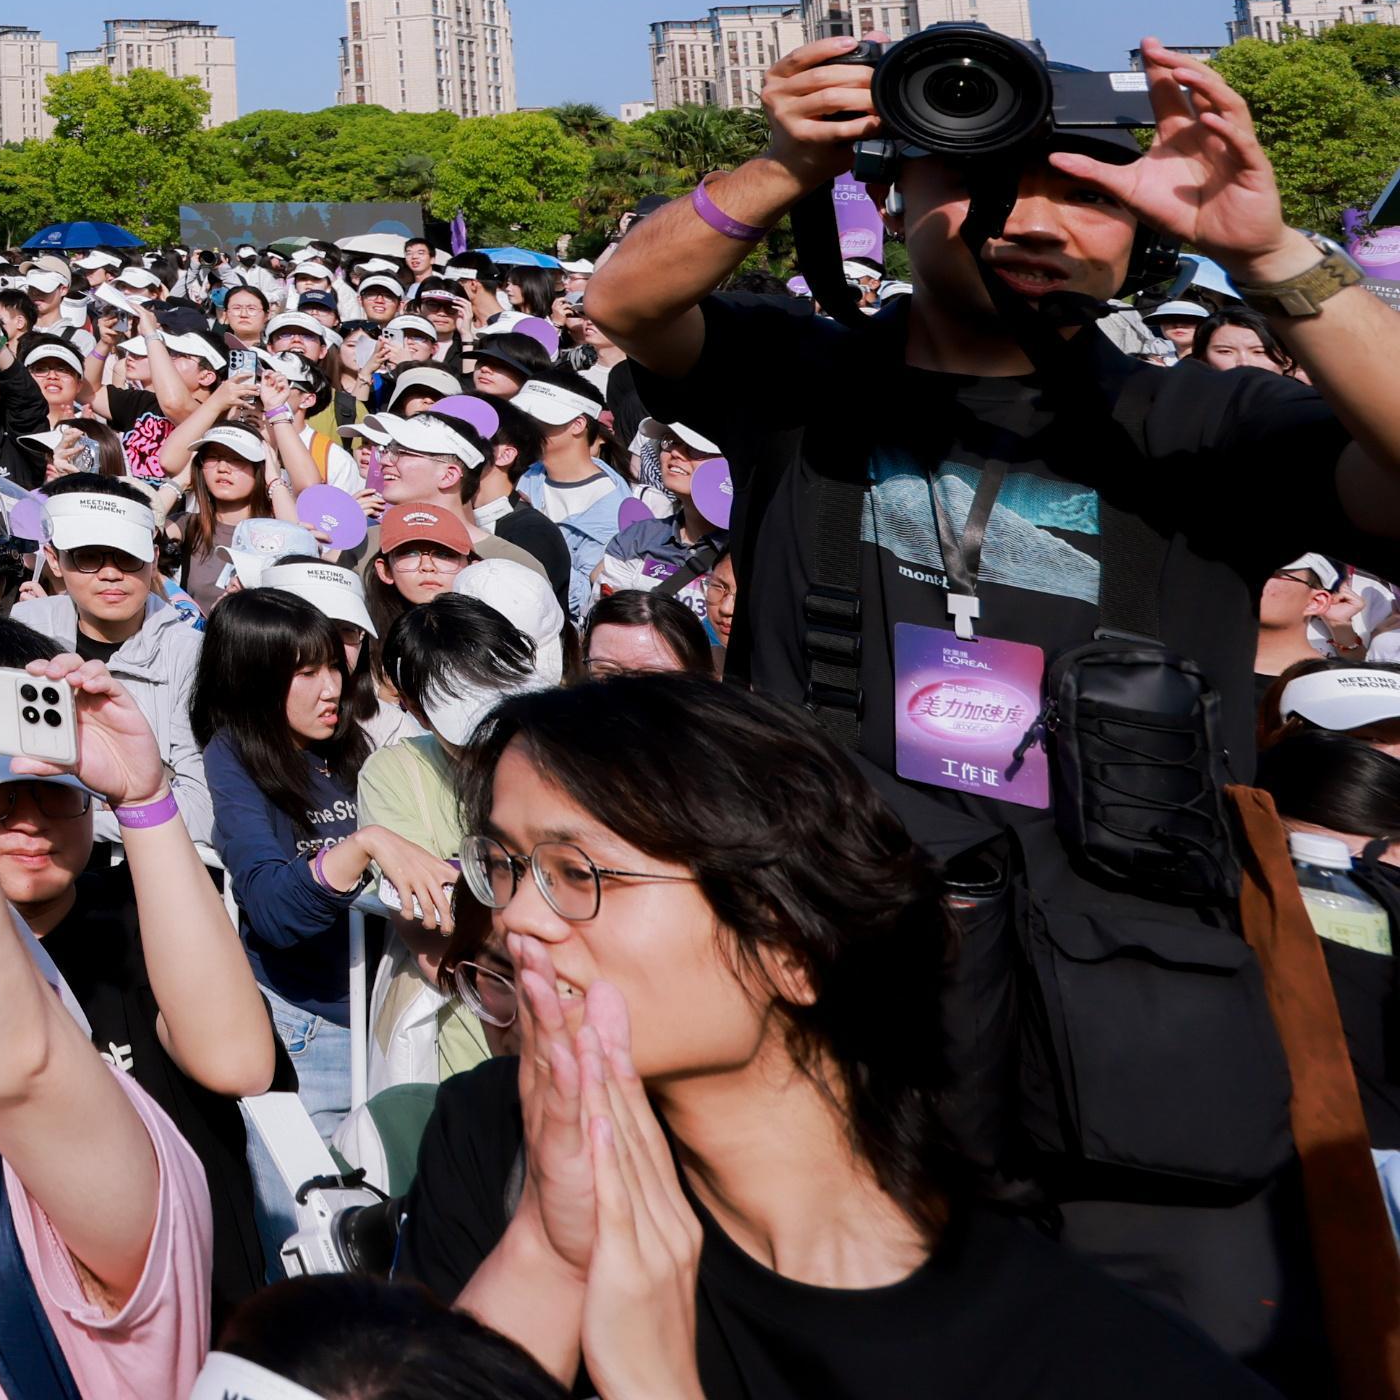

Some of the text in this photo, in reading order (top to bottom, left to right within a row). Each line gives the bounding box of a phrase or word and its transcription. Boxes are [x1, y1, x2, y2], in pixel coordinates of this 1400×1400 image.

[79, 499, 117, 508] MEETING
[90, 504, 127, 516] MOMENT
[307, 569, 345, 579] MEETING
[1337, 676, 1397, 686] MEETING
[1358, 682, 1400, 691] MOME
[941, 758, 1000, 787] 工作证
